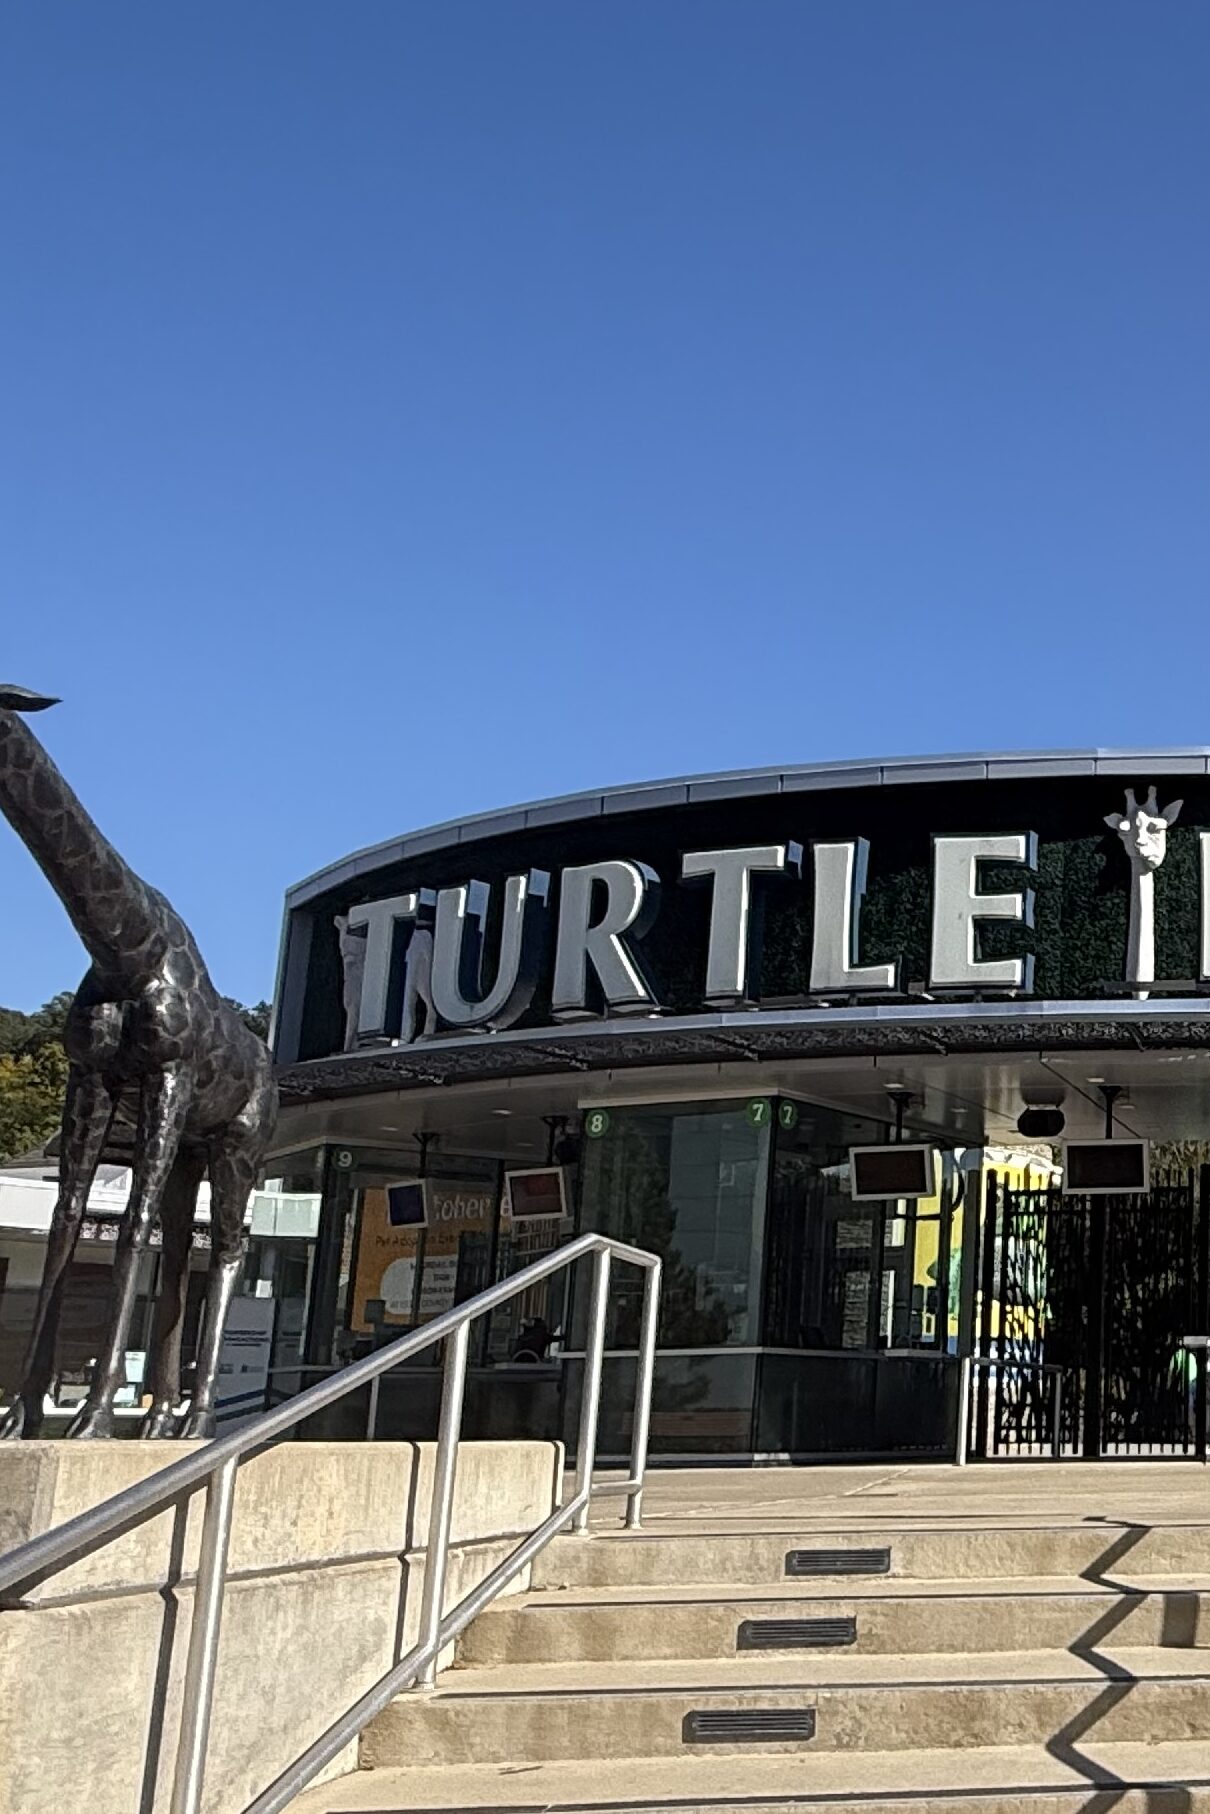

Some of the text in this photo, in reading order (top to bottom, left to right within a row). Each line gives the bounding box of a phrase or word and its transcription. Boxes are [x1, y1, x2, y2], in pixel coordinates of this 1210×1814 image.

[348, 831, 1038, 1048] TURTLE
[752, 1103, 763, 1121] 7
[783, 1105, 793, 1124] 7
[591, 1114, 603, 1133] 8
[339, 1151, 353, 1167] 9
